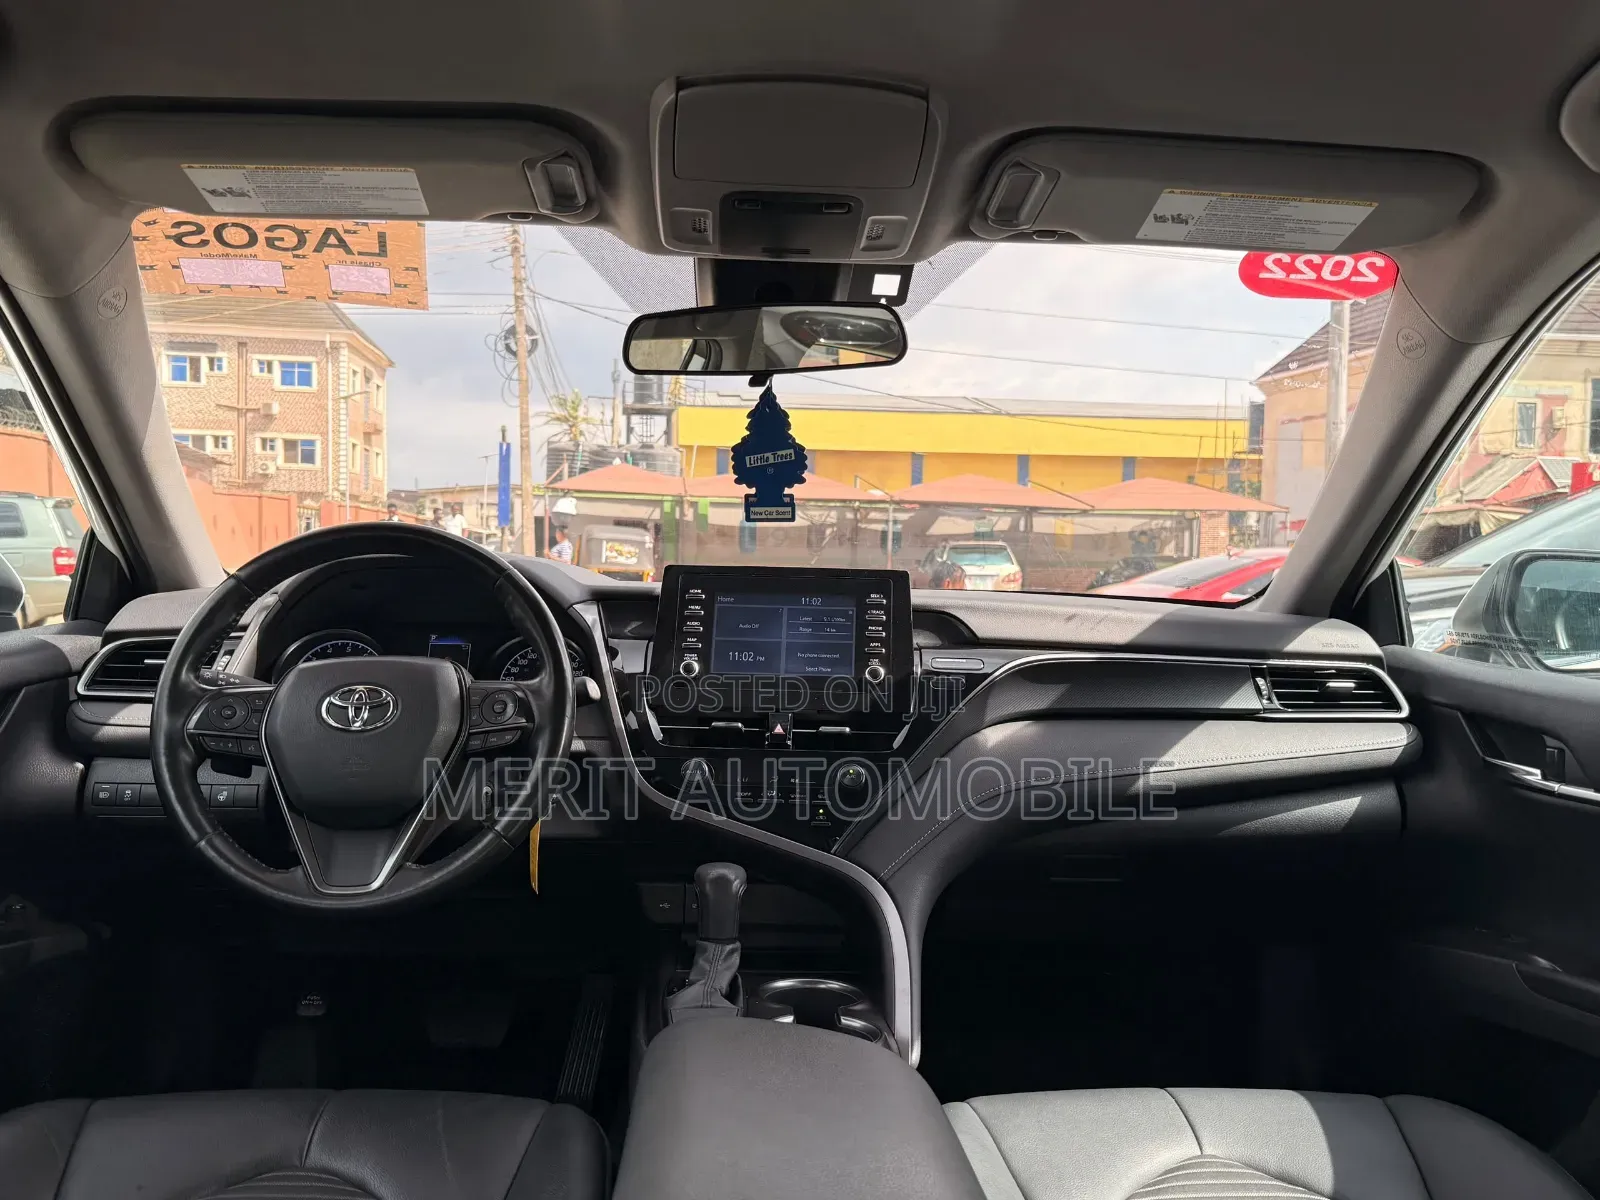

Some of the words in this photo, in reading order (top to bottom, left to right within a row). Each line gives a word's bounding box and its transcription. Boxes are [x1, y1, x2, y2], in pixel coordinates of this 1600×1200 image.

[1227, 193, 1303, 202] AVERTISSEMENT
[748, 454, 770, 466] Little
[770, 452, 793, 462] Trees
[801, 597, 822, 606] 11:02
[527, 651, 537, 659] 120
[728, 652, 754, 661] 11:02
